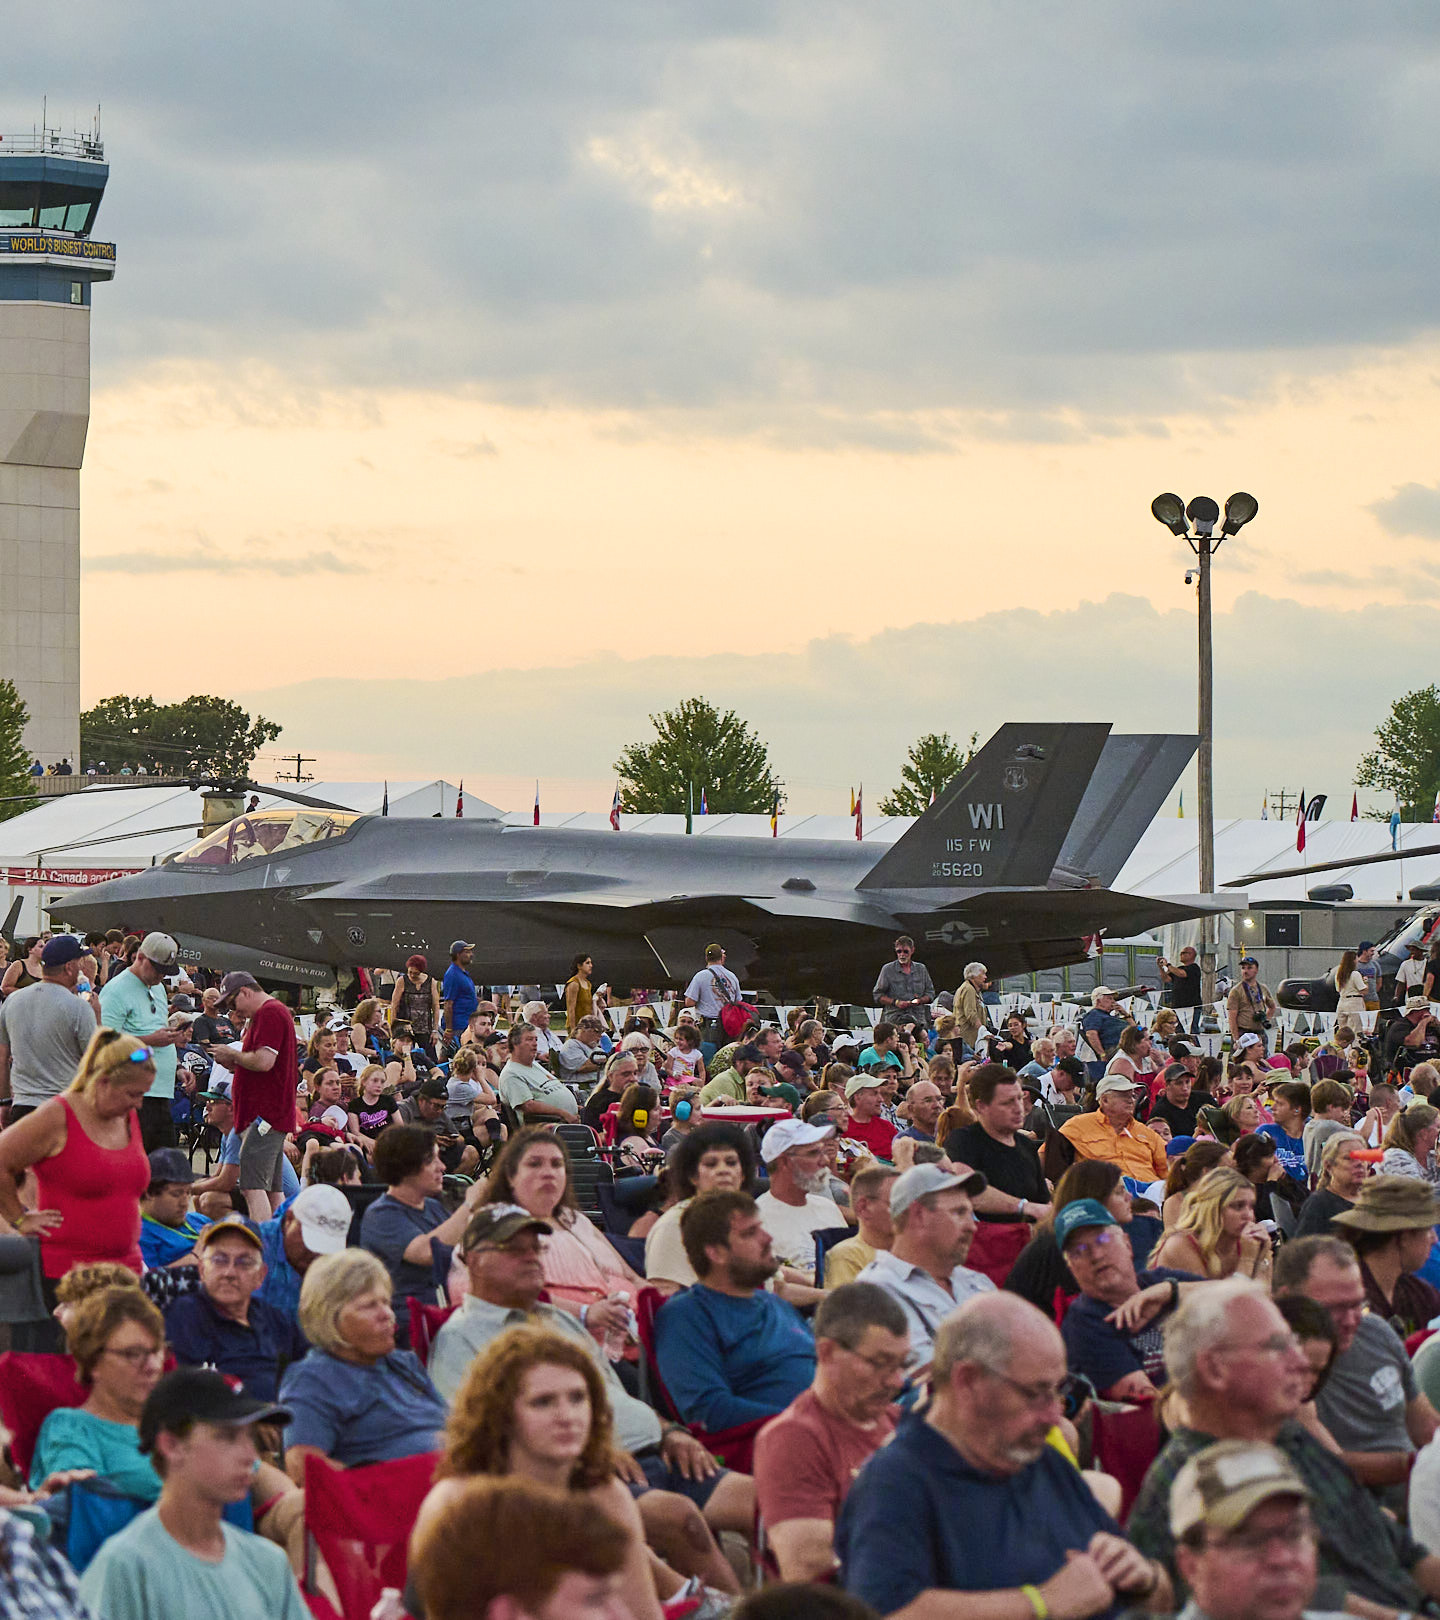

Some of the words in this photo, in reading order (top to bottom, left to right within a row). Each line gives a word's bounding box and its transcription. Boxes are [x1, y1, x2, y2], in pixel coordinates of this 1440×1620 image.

[11, 237, 53, 252] WORLD'S
[54, 239, 82, 254] BUSIEST
[83, 243, 116, 259] CONTROL
[968, 803, 1004, 830] WI
[946, 839, 962, 852] 115
[942, 863, 983, 877] 5620
[49, 871, 88, 884] Canada
